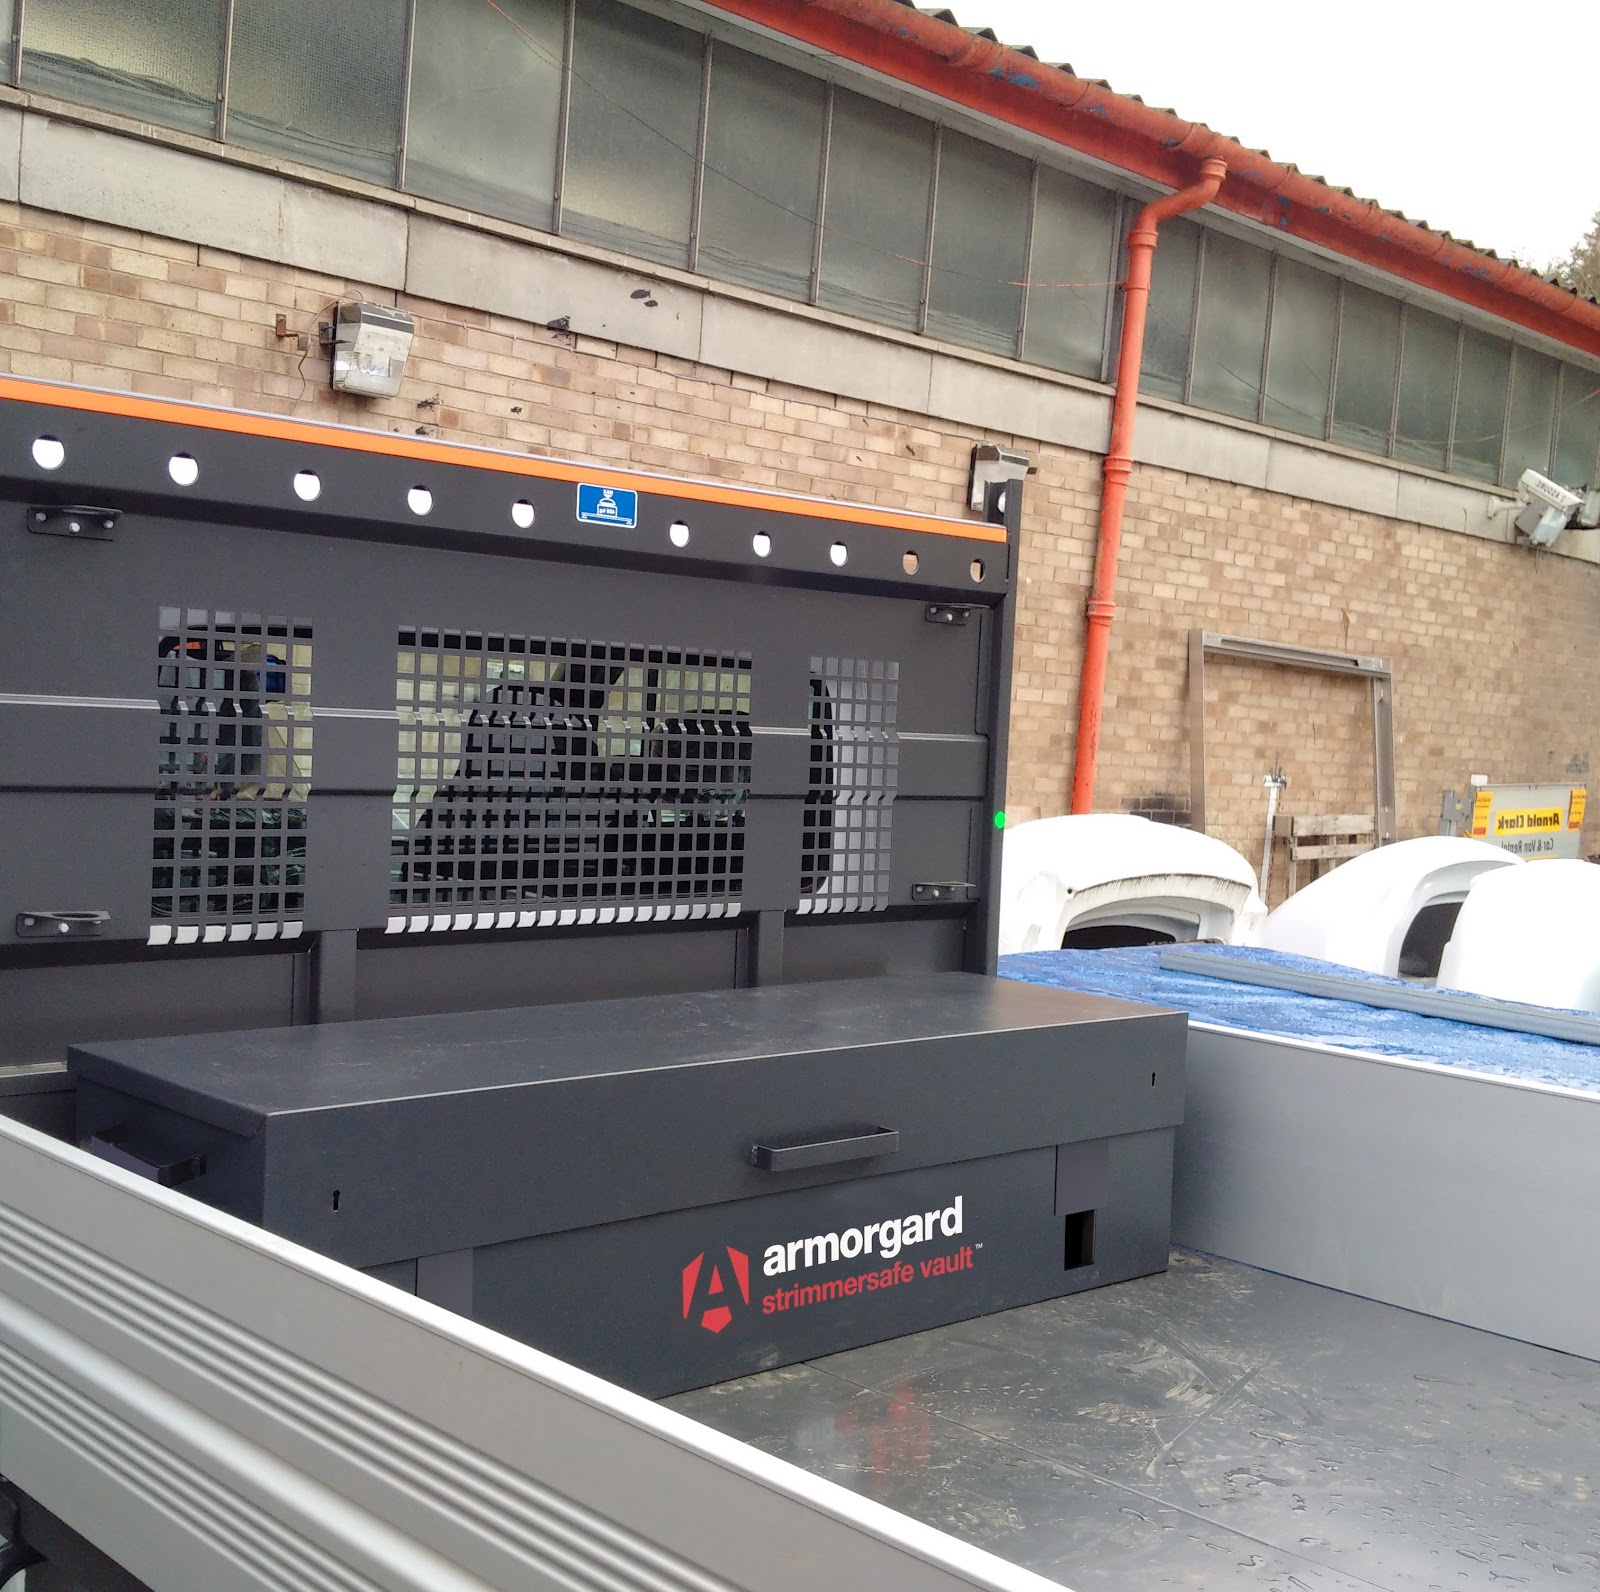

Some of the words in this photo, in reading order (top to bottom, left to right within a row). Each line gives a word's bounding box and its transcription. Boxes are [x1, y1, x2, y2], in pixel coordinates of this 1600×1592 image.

[763, 1195, 963, 1277] armorgard
[762, 1260, 914, 1314] strimmersafe
[919, 1246, 974, 1279] vault
